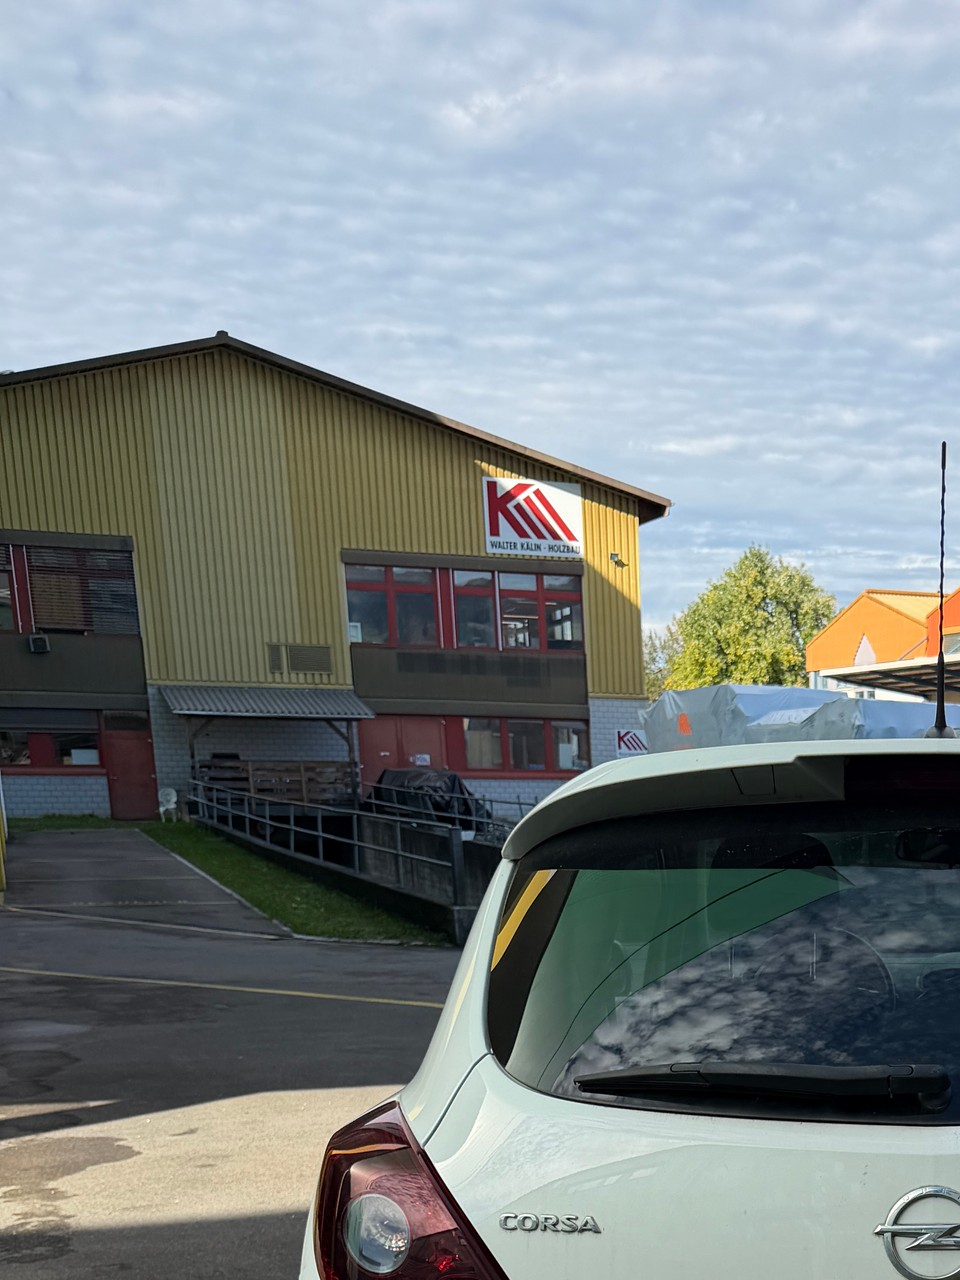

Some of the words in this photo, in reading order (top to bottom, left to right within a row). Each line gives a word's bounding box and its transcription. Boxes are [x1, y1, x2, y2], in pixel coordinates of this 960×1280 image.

[490, 541, 518, 551] WALTER
[520, 542, 542, 552] KÄLIN
[548, 544, 581, 555] HOLZBAU
[499, 1212, 602, 1234] CORSA
